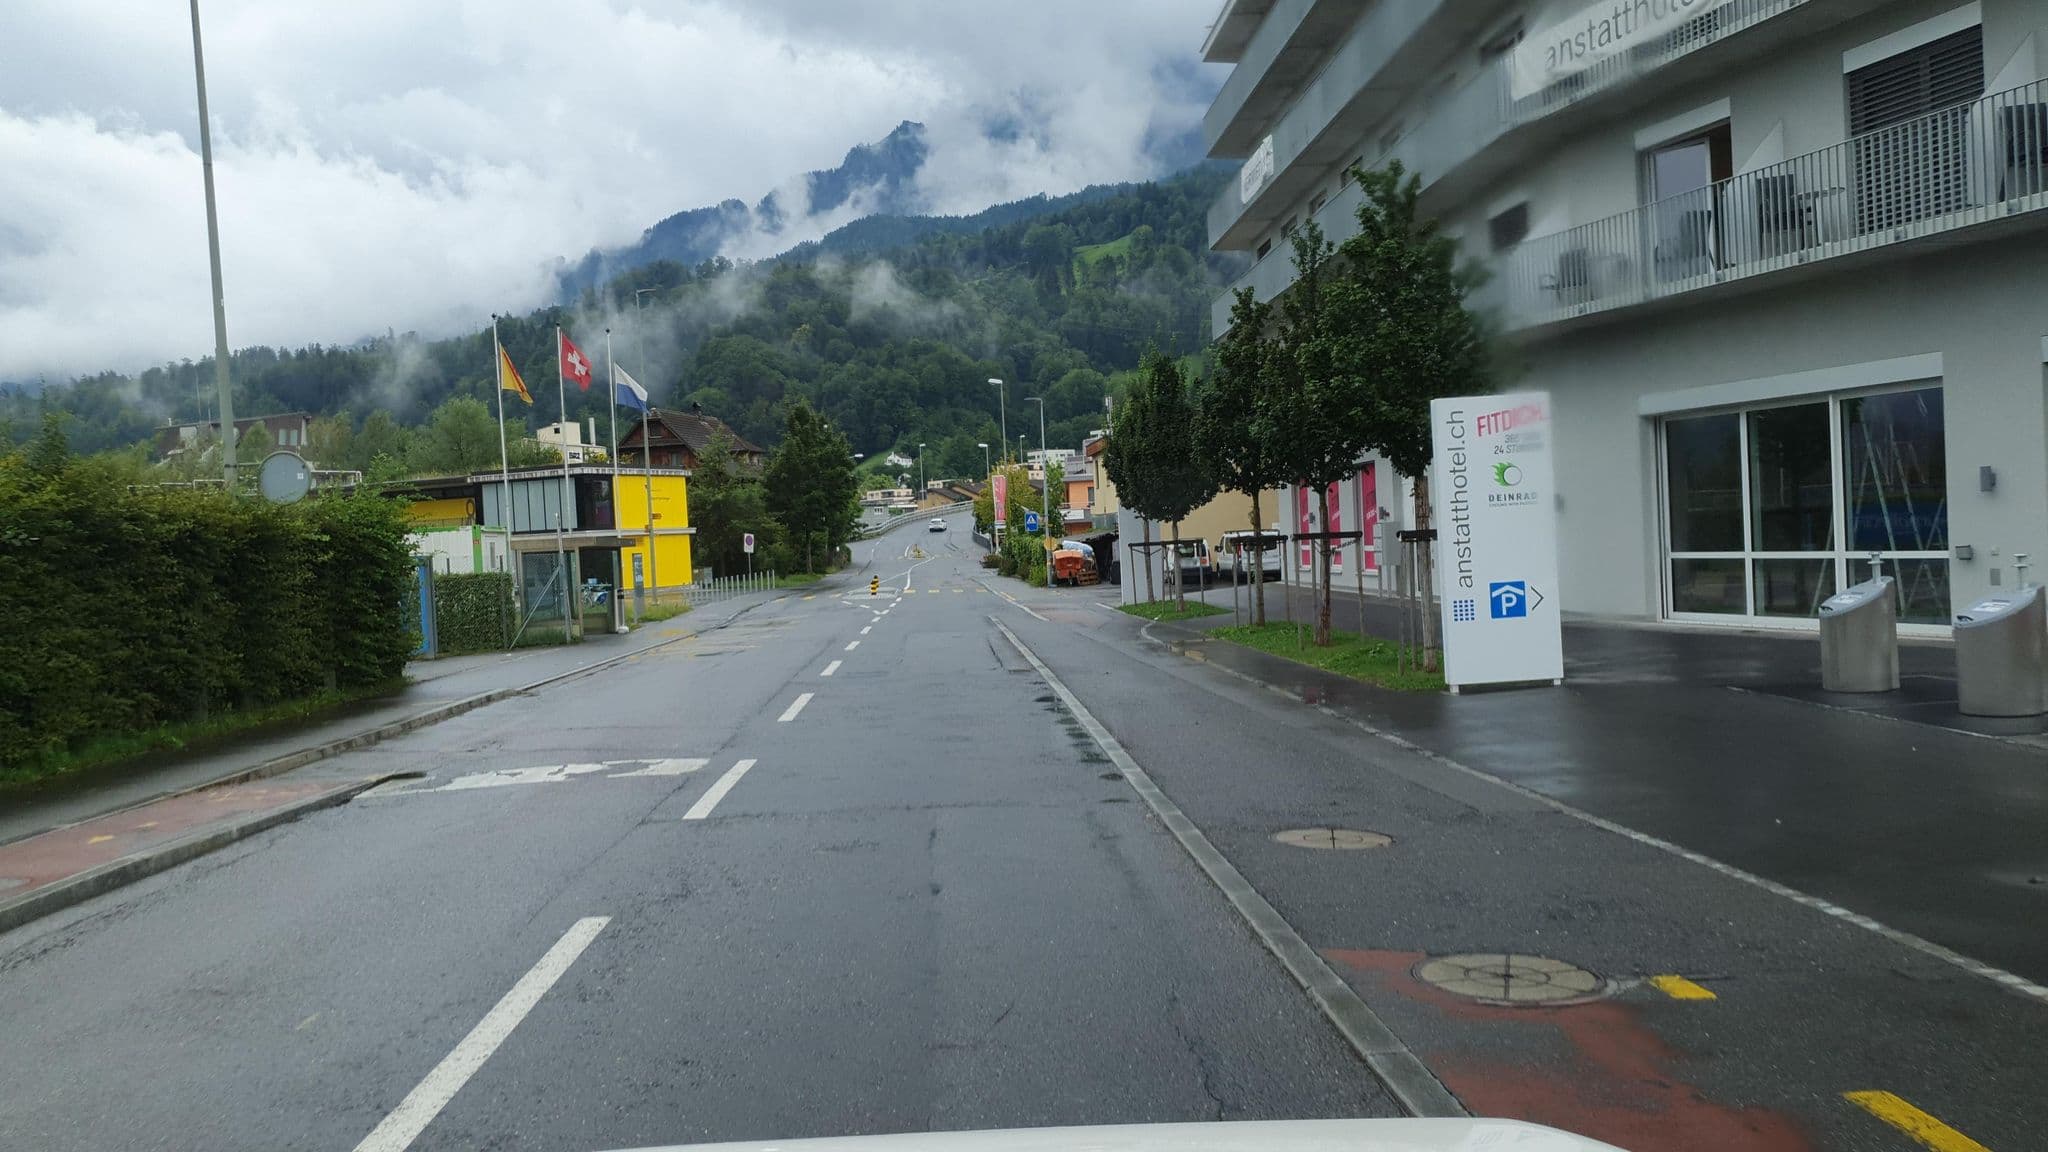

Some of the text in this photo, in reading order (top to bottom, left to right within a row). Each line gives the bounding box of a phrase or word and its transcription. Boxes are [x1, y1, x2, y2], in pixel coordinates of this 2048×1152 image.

[1544, 0, 1694, 70] anstattho
[1494, 445, 1504, 455] 24
[1446, 410, 1474, 589] anstatthotel.ch
[1501, 593, 1517, 616] P
